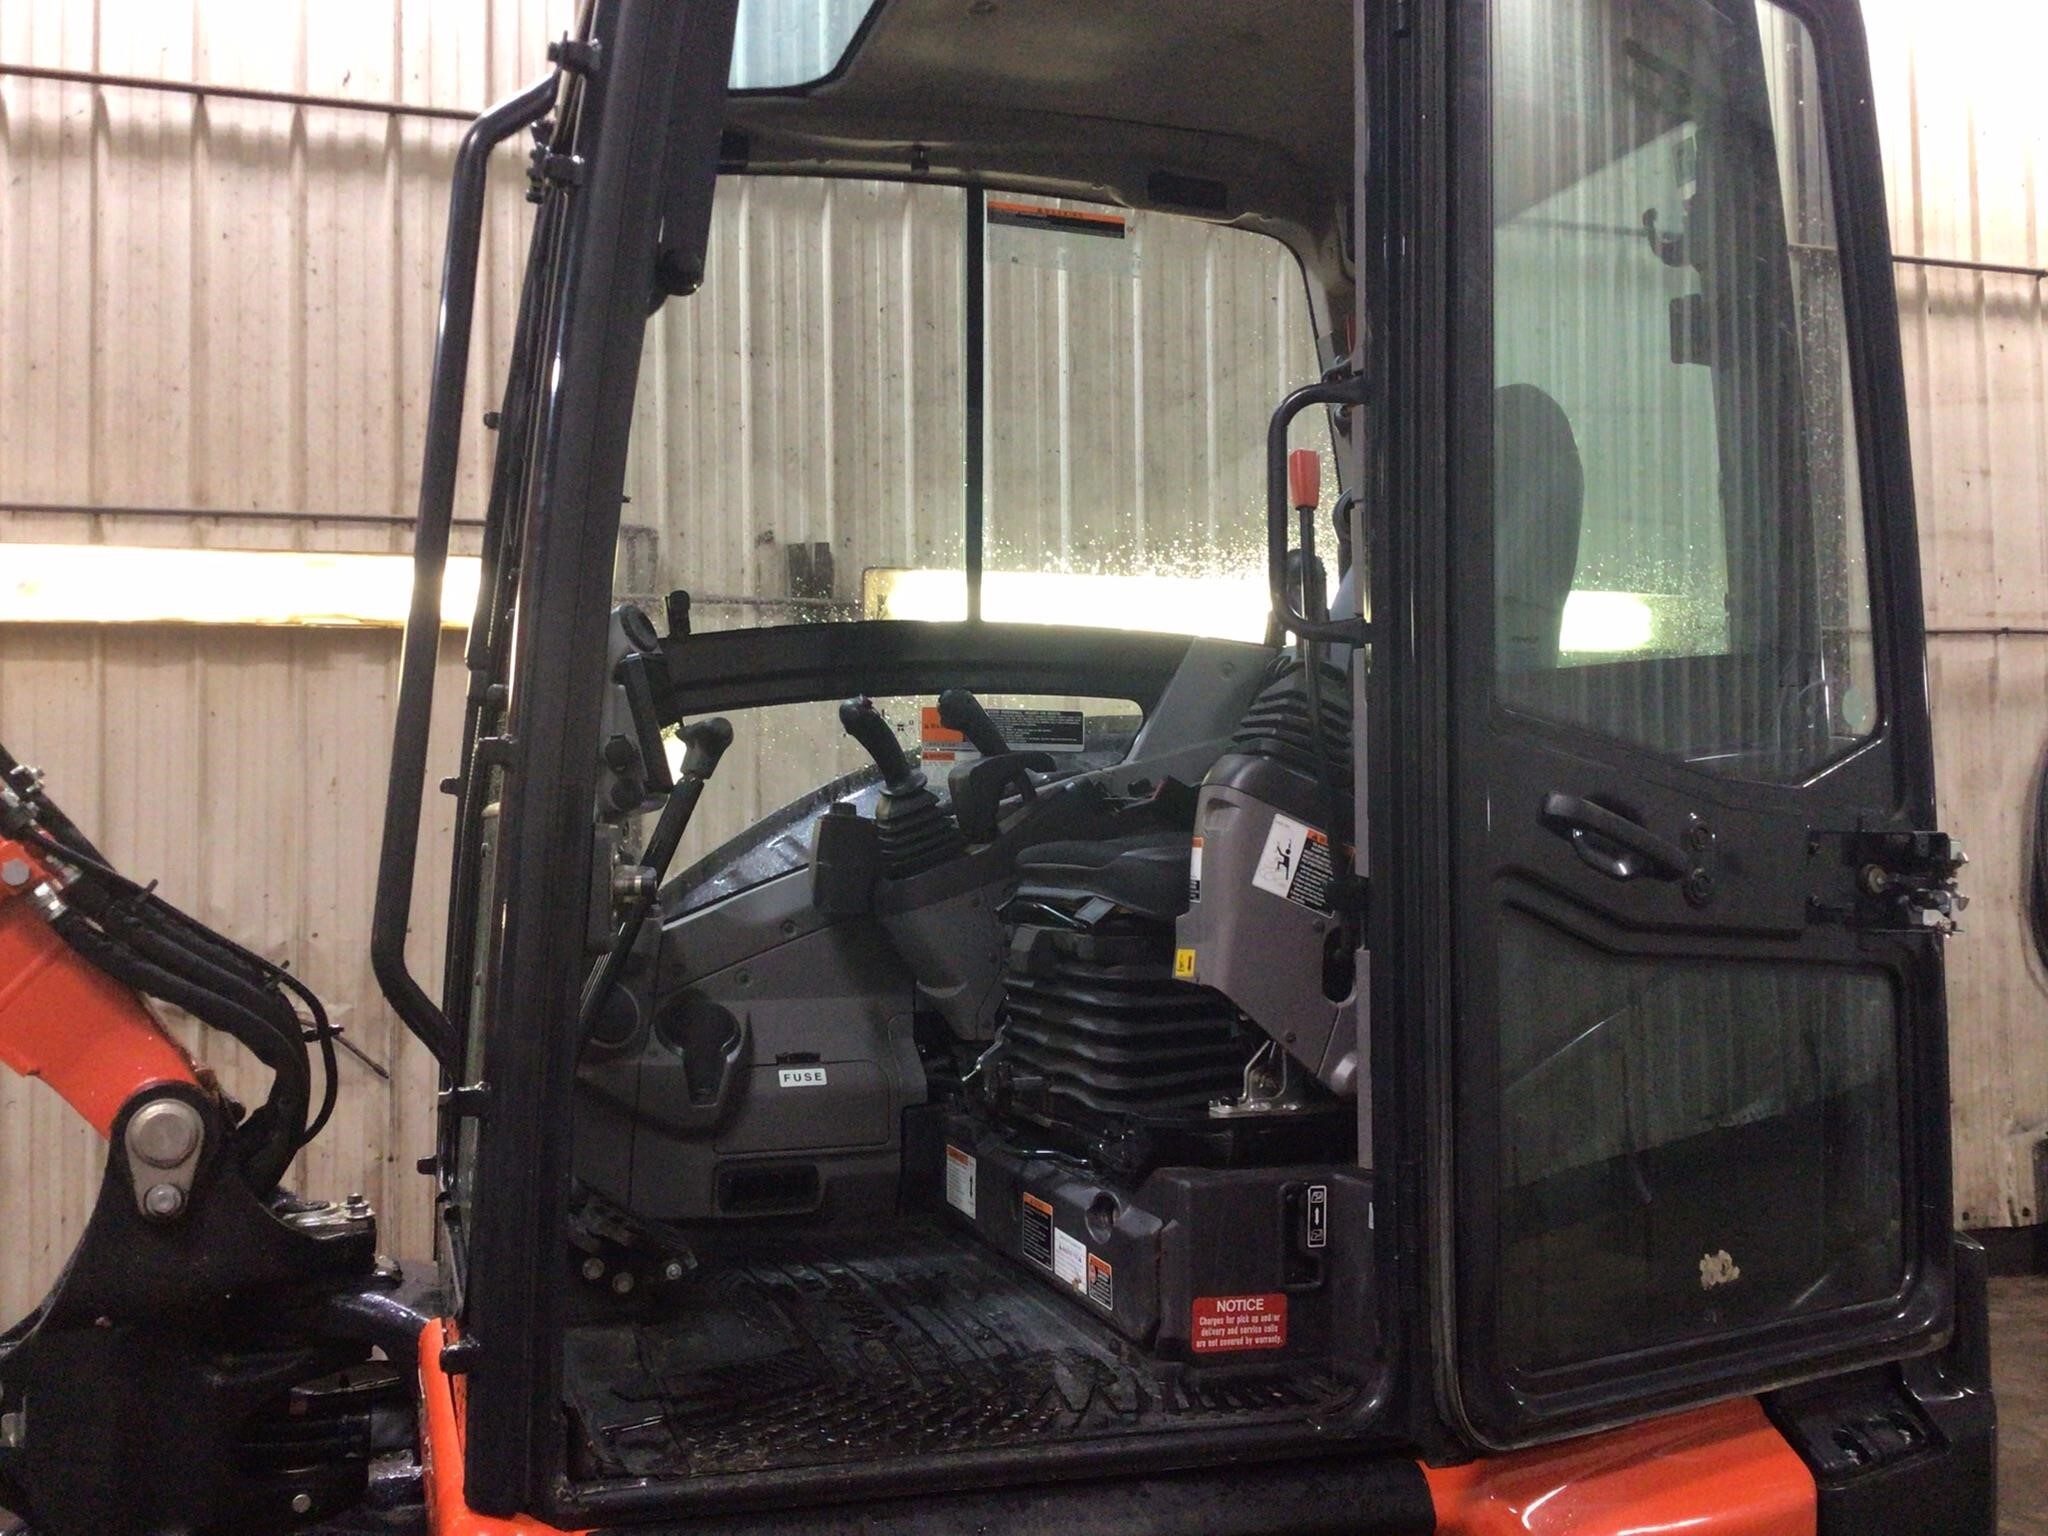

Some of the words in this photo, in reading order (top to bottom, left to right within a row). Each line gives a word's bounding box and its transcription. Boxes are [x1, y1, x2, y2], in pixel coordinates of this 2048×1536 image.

[783, 1072, 823, 1082] FUSE
[1216, 1298, 1265, 1312] NOTICE
[1199, 1316, 1224, 1327] Charges
[1226, 1315, 1235, 1324] for
[1236, 1314, 1249, 1325] pick
[1201, 1327, 1225, 1337] delivery
[1227, 1326, 1238, 1335] and
[1240, 1325, 1262, 1334] service
[1263, 1324, 1278, 1333] calls
[1196, 1340, 1206, 1348] are
[1208, 1338, 1218, 1347] not
[1219, 1336, 1244, 1346] covered
[1245, 1336, 1253, 1346] by
